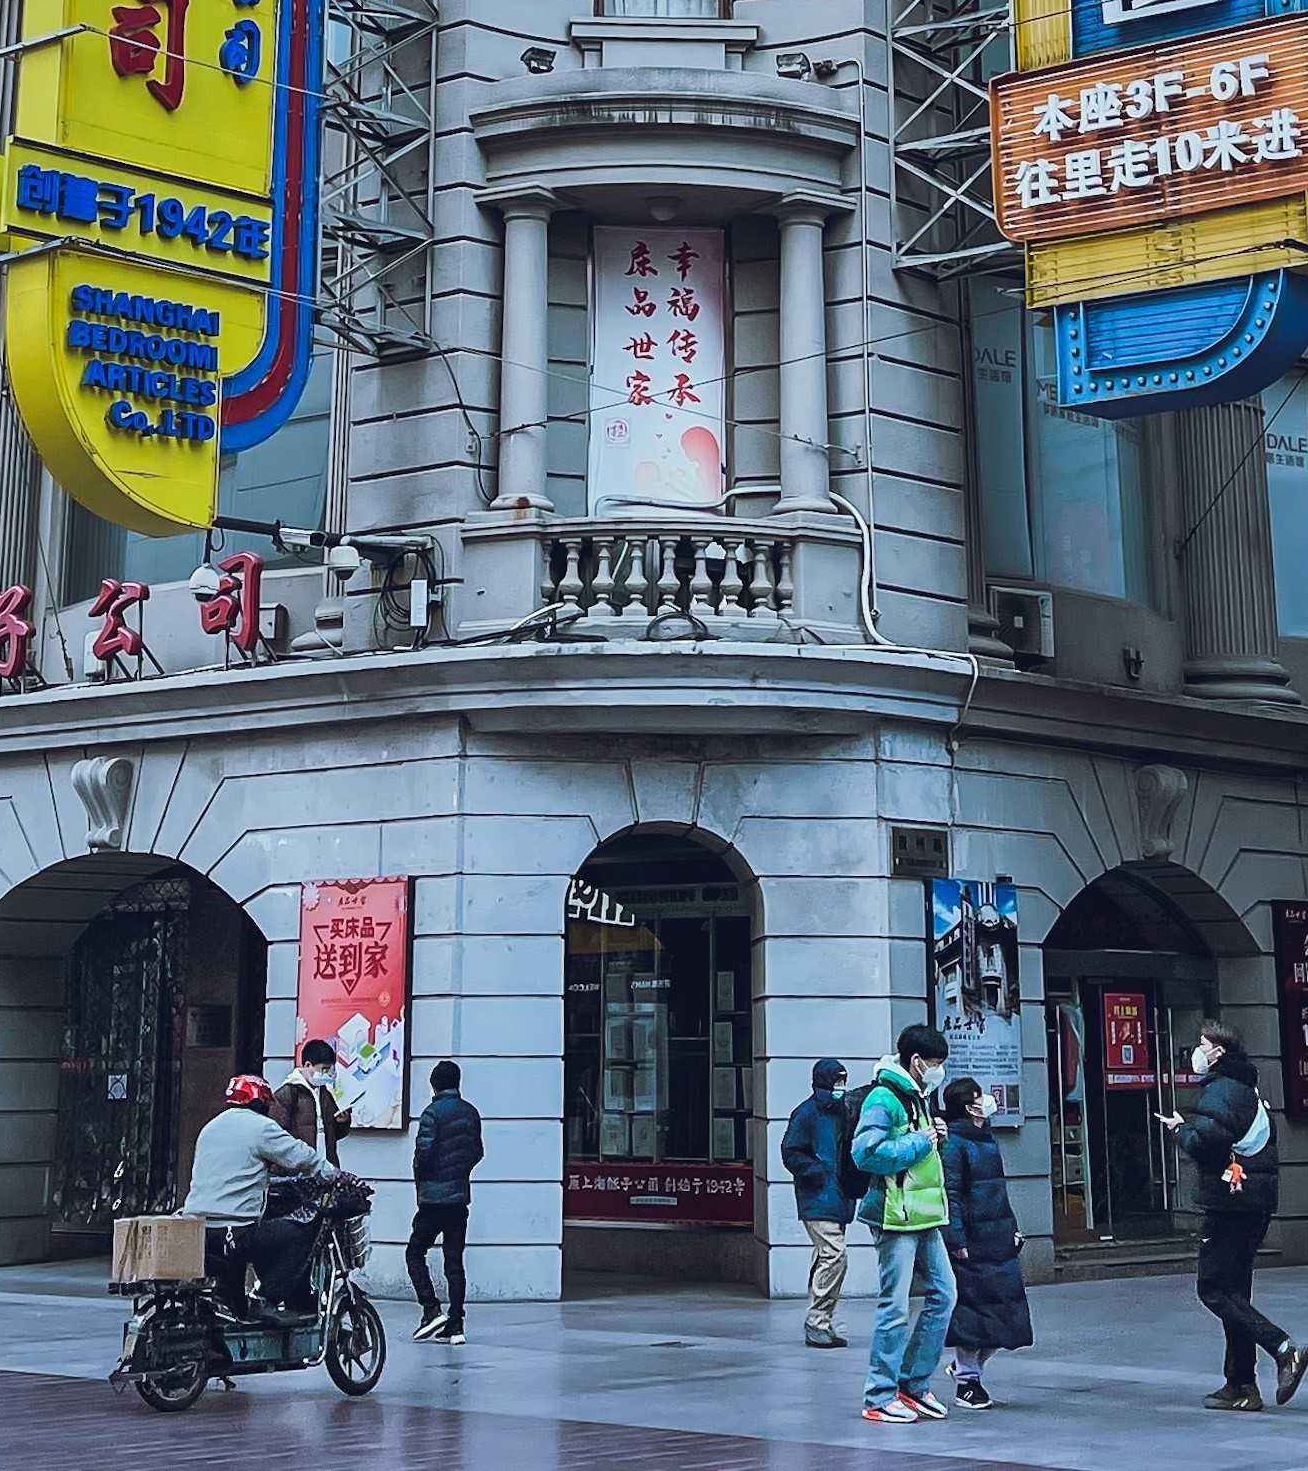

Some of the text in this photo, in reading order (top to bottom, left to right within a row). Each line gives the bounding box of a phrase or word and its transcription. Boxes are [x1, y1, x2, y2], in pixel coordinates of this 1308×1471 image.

[1014, 109, 1303, 209] 往里走10米进
[72, 285, 220, 337] SHANGHAI
[622, 240, 659, 407] 床品世家
[665, 241, 702, 407] 幸福传承
[68, 319, 219, 372] BEDROOM
[81, 359, 218, 407] ARTICLES
[330, 917, 375, 940] 买床品
[313, 941, 390, 981] 送到家
